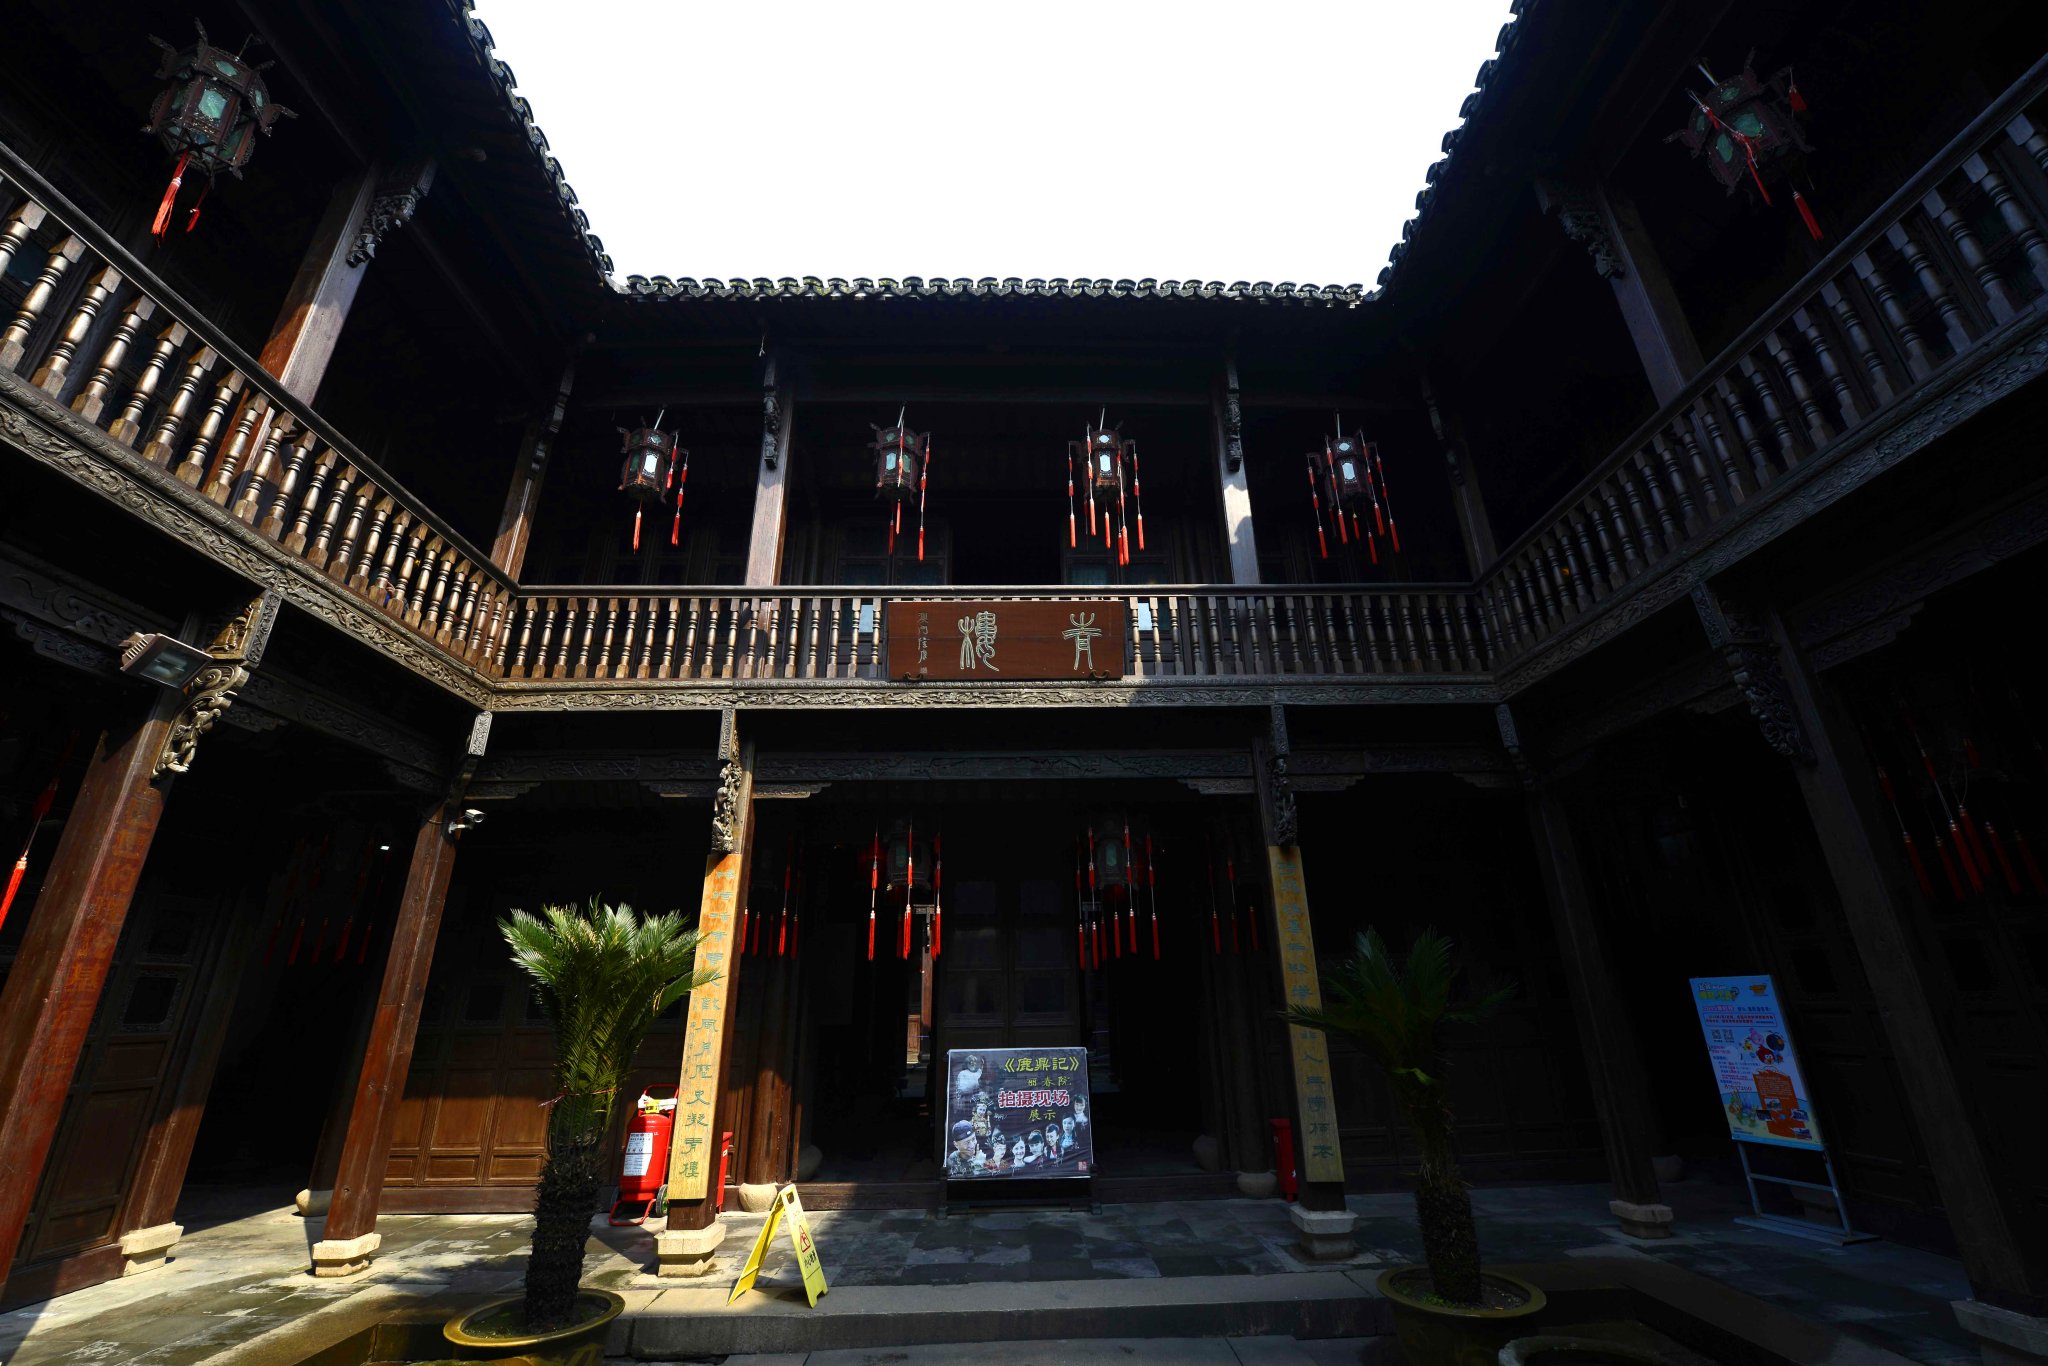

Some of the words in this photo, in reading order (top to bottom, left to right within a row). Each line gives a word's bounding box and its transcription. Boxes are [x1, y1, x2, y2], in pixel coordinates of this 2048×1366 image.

[1026, 1076, 1073, 1087] 丽春院
[998, 1089, 1071, 1108] 拍摄现场
[1028, 1109, 1057, 1122] 展示
